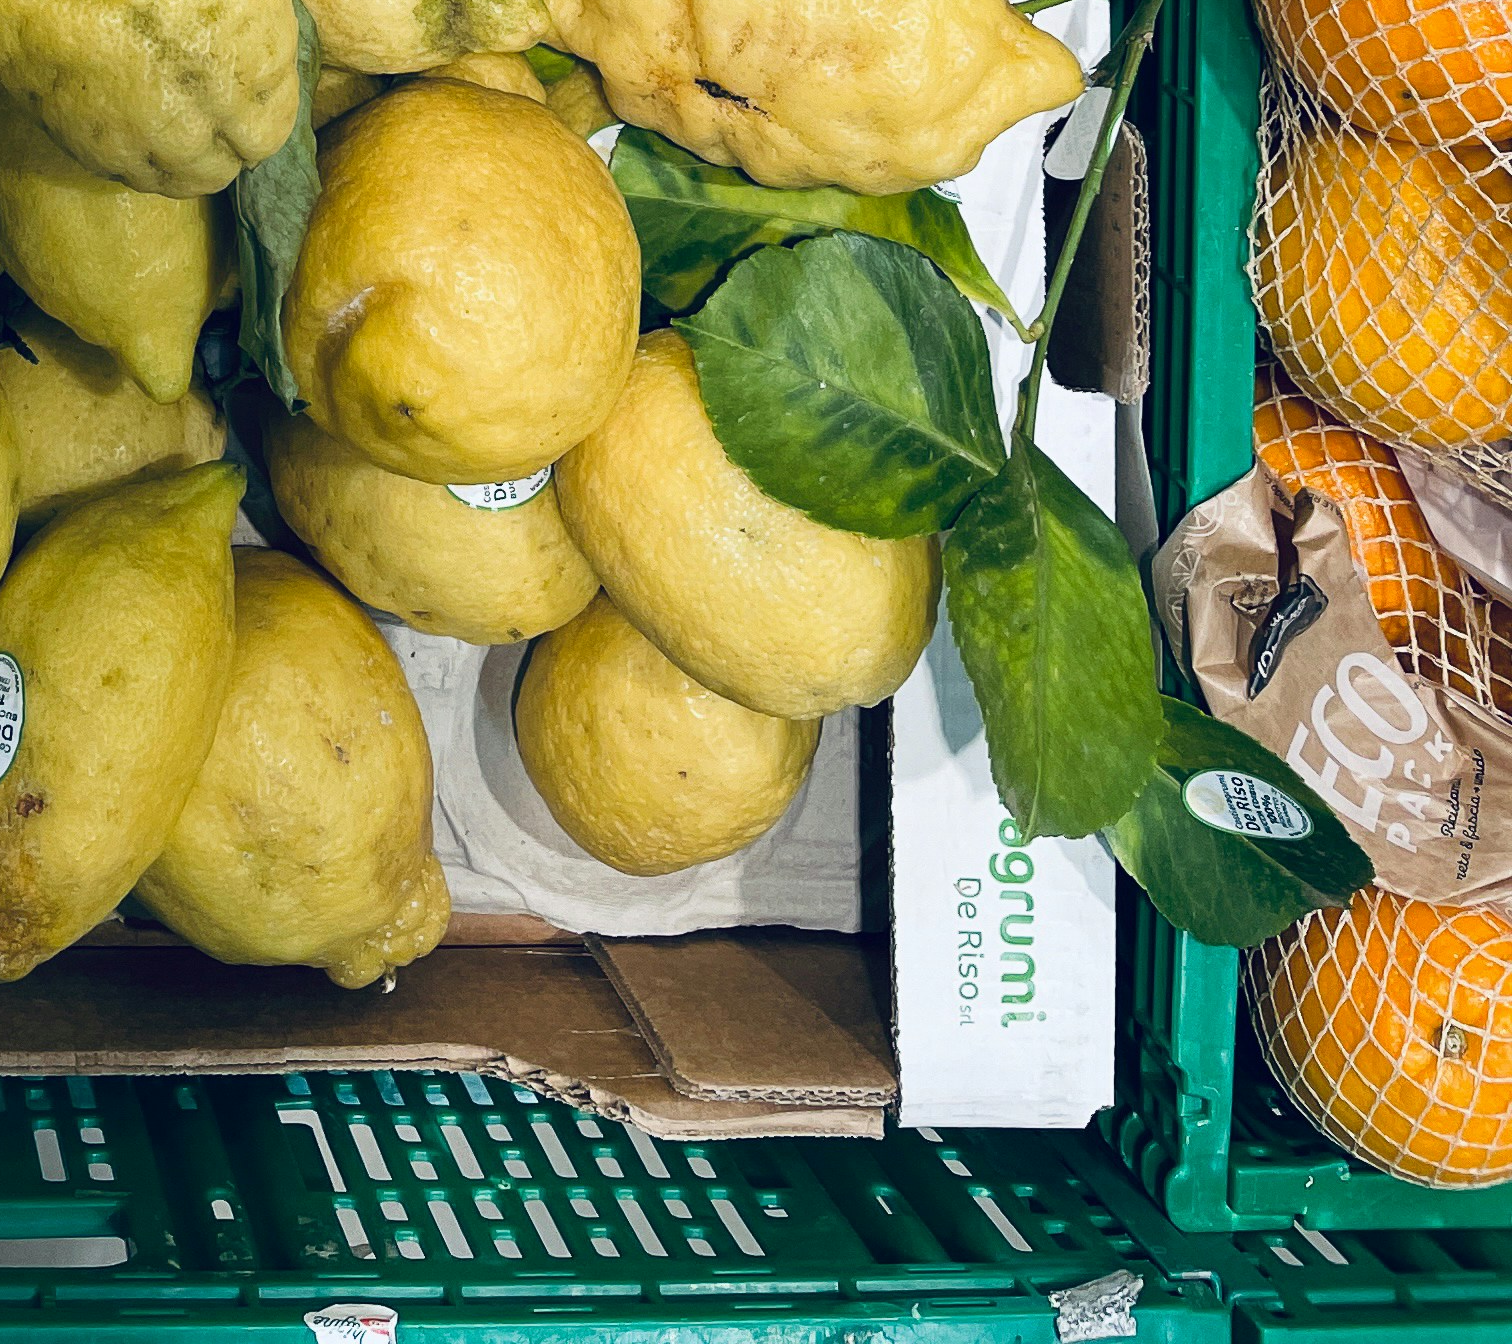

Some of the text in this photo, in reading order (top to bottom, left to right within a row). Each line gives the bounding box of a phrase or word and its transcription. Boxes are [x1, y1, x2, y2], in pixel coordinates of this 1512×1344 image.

[1231, 776, 1261, 832] De Riso
[1284, 652, 1430, 835] ECO
[1386, 728, 1454, 854] PACK
[1260, 794, 1280, 825] 100%
[956, 877, 985, 1027] De Riso srl
